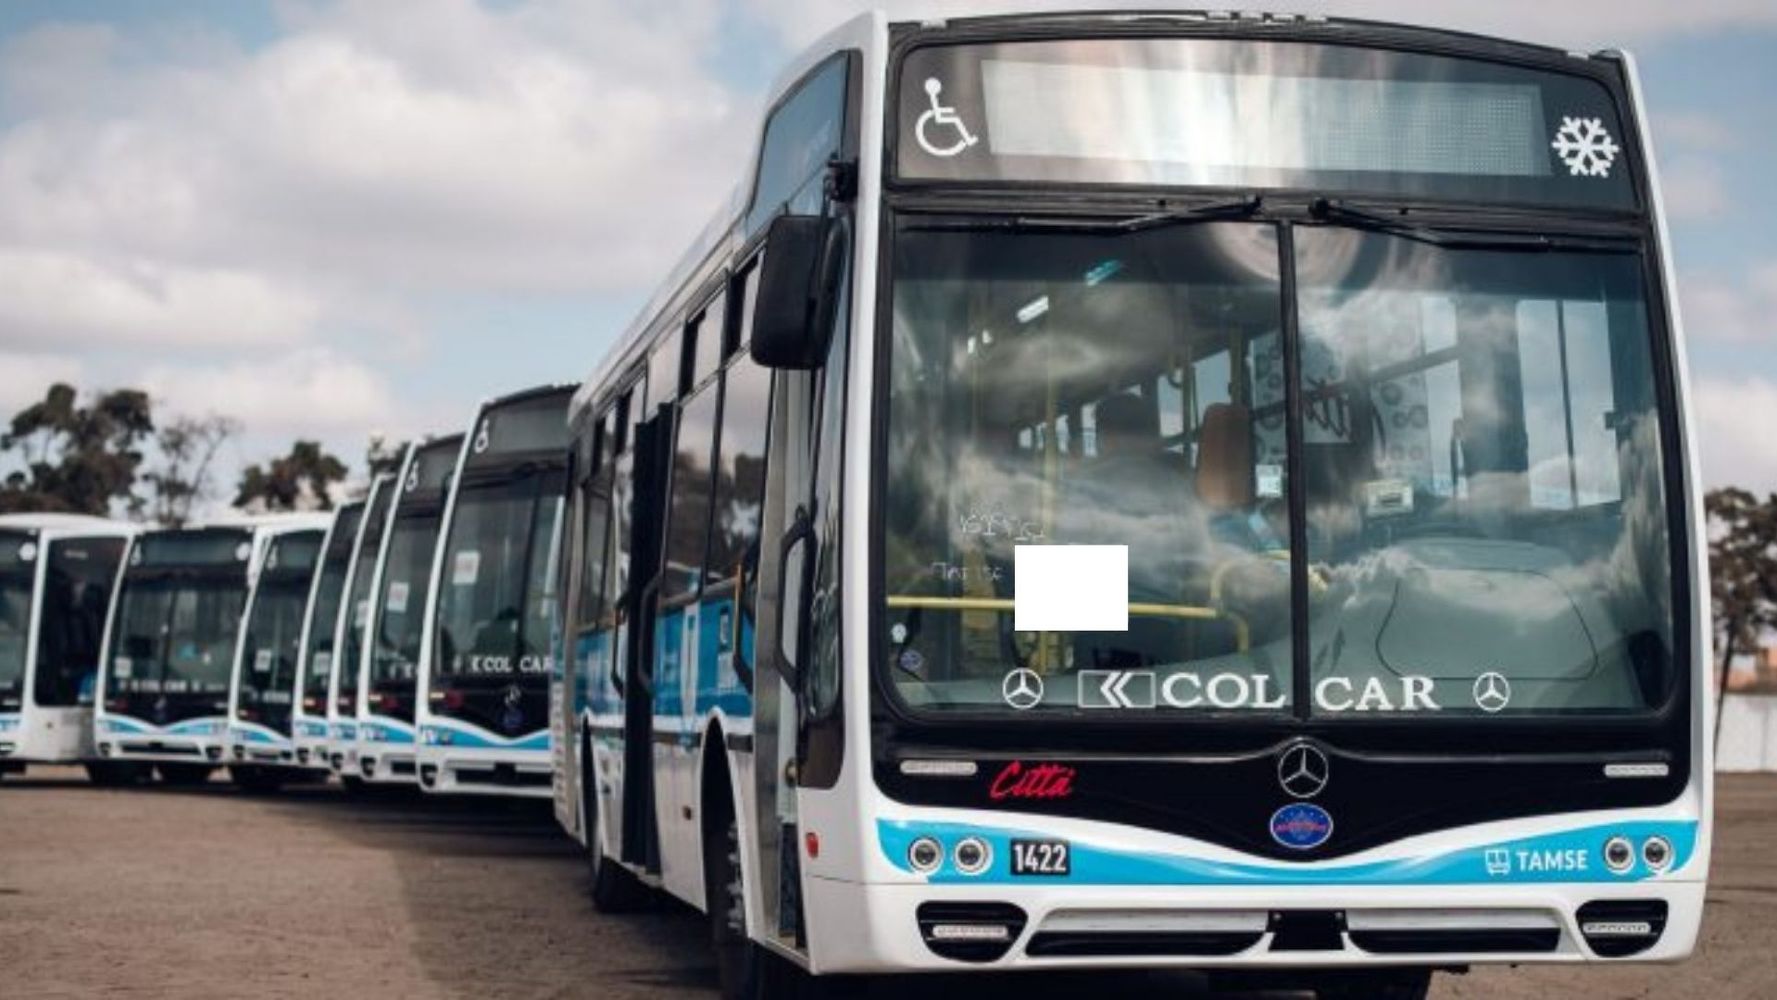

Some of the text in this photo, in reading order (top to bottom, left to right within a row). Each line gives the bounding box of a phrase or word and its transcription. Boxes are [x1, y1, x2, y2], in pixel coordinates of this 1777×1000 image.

[1161, 672, 1442, 711] COL CAR
[1013, 843, 1068, 873] 1422
[1515, 849, 1589, 872] TAMSE
